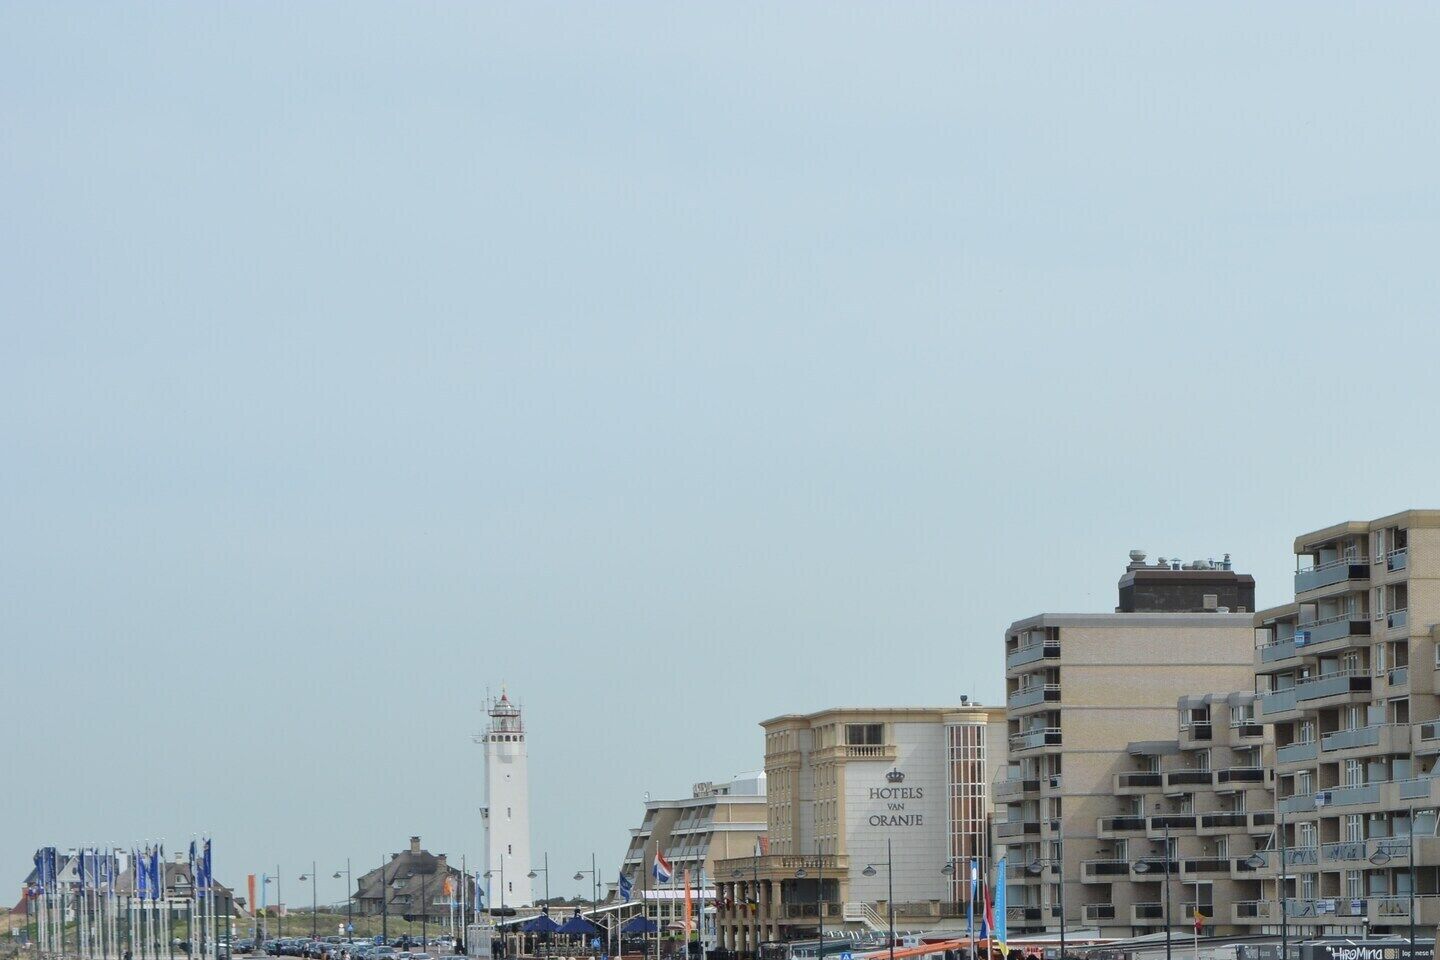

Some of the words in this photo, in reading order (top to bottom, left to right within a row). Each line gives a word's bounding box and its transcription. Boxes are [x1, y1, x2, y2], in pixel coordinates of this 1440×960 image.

[869, 787, 923, 799] HOTELS
[869, 814, 923, 826] ORANJE
[1402, 950, 1431, 958] Japnese
